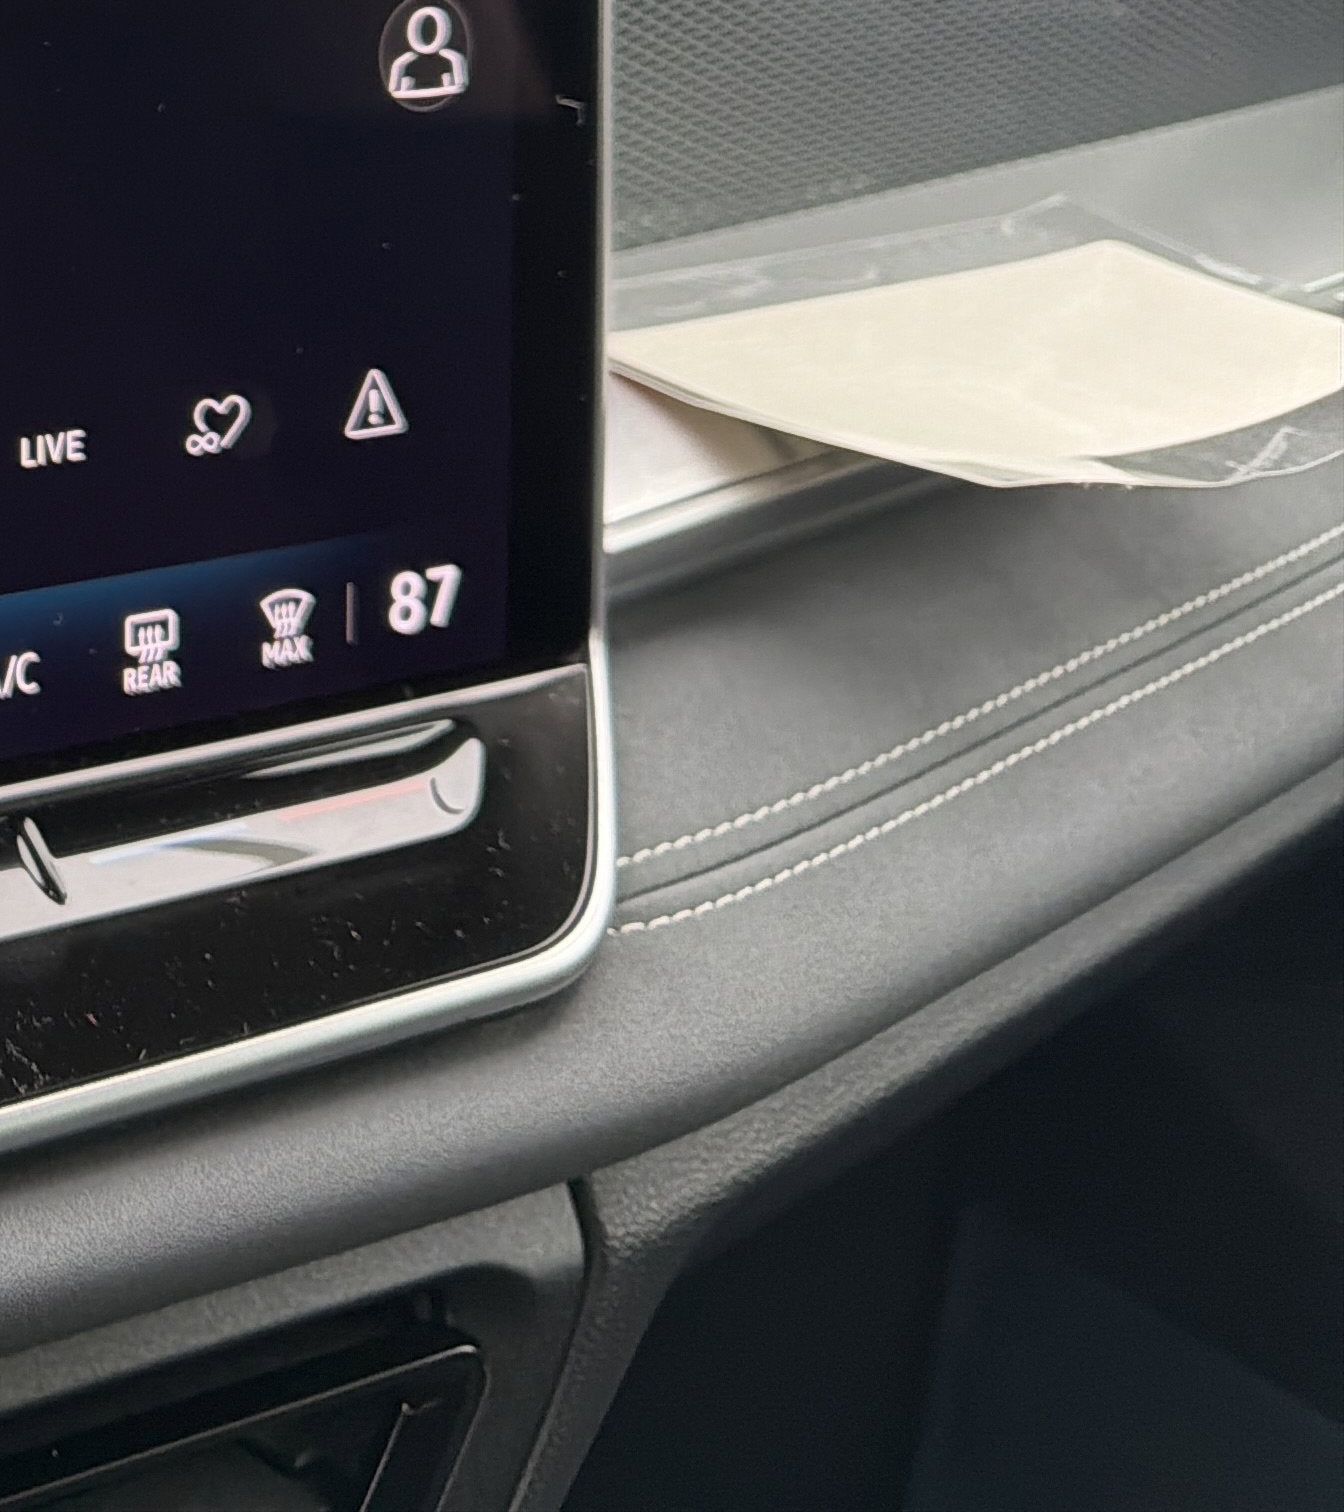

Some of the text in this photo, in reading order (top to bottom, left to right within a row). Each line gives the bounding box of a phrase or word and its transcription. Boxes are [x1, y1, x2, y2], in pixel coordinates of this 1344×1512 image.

[20, 429, 87, 469] LIVE
[388, 563, 462, 635] 87
[262, 635, 313, 669] MAX
[123, 660, 181, 695] REAR
